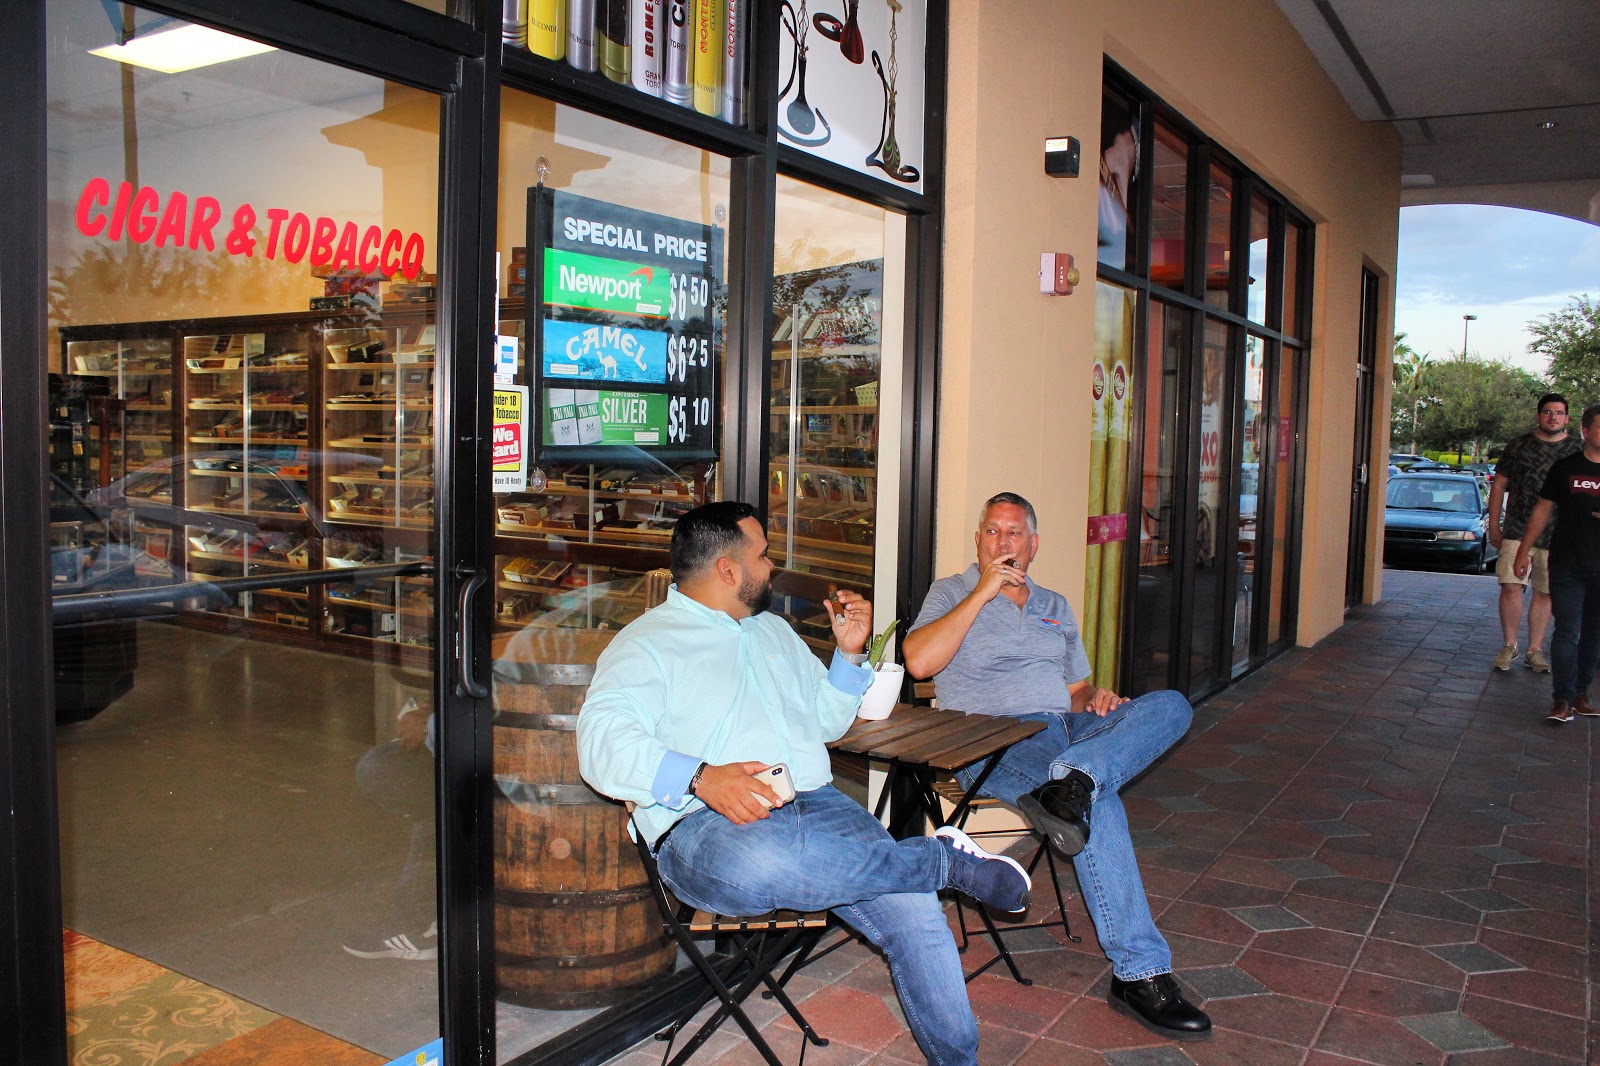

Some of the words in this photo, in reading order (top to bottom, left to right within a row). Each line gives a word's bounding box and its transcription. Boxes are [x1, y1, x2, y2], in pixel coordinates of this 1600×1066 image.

[672, 0, 685, 27] C
[644, 0, 654, 58] ROME
[670, 38, 685, 52] TORO
[75, 177, 221, 253] CIGAR
[225, 203, 257, 257] &
[266, 208, 425, 280] TOBACCO
[564, 216, 648, 252] SPECIAL
[654, 233, 707, 262] PRICE
[559, 264, 642, 302] Newport
[566, 326, 647, 372] CAMEL
[493, 395, 508, 406] nder
[510, 395, 517, 406] 18
[496, 407, 519, 420] Tobacco
[602, 397, 647, 424] SILVER
[493, 427, 514, 443] We
[492, 440, 519, 458] ard
[1573, 480, 1600, 490] Lev
